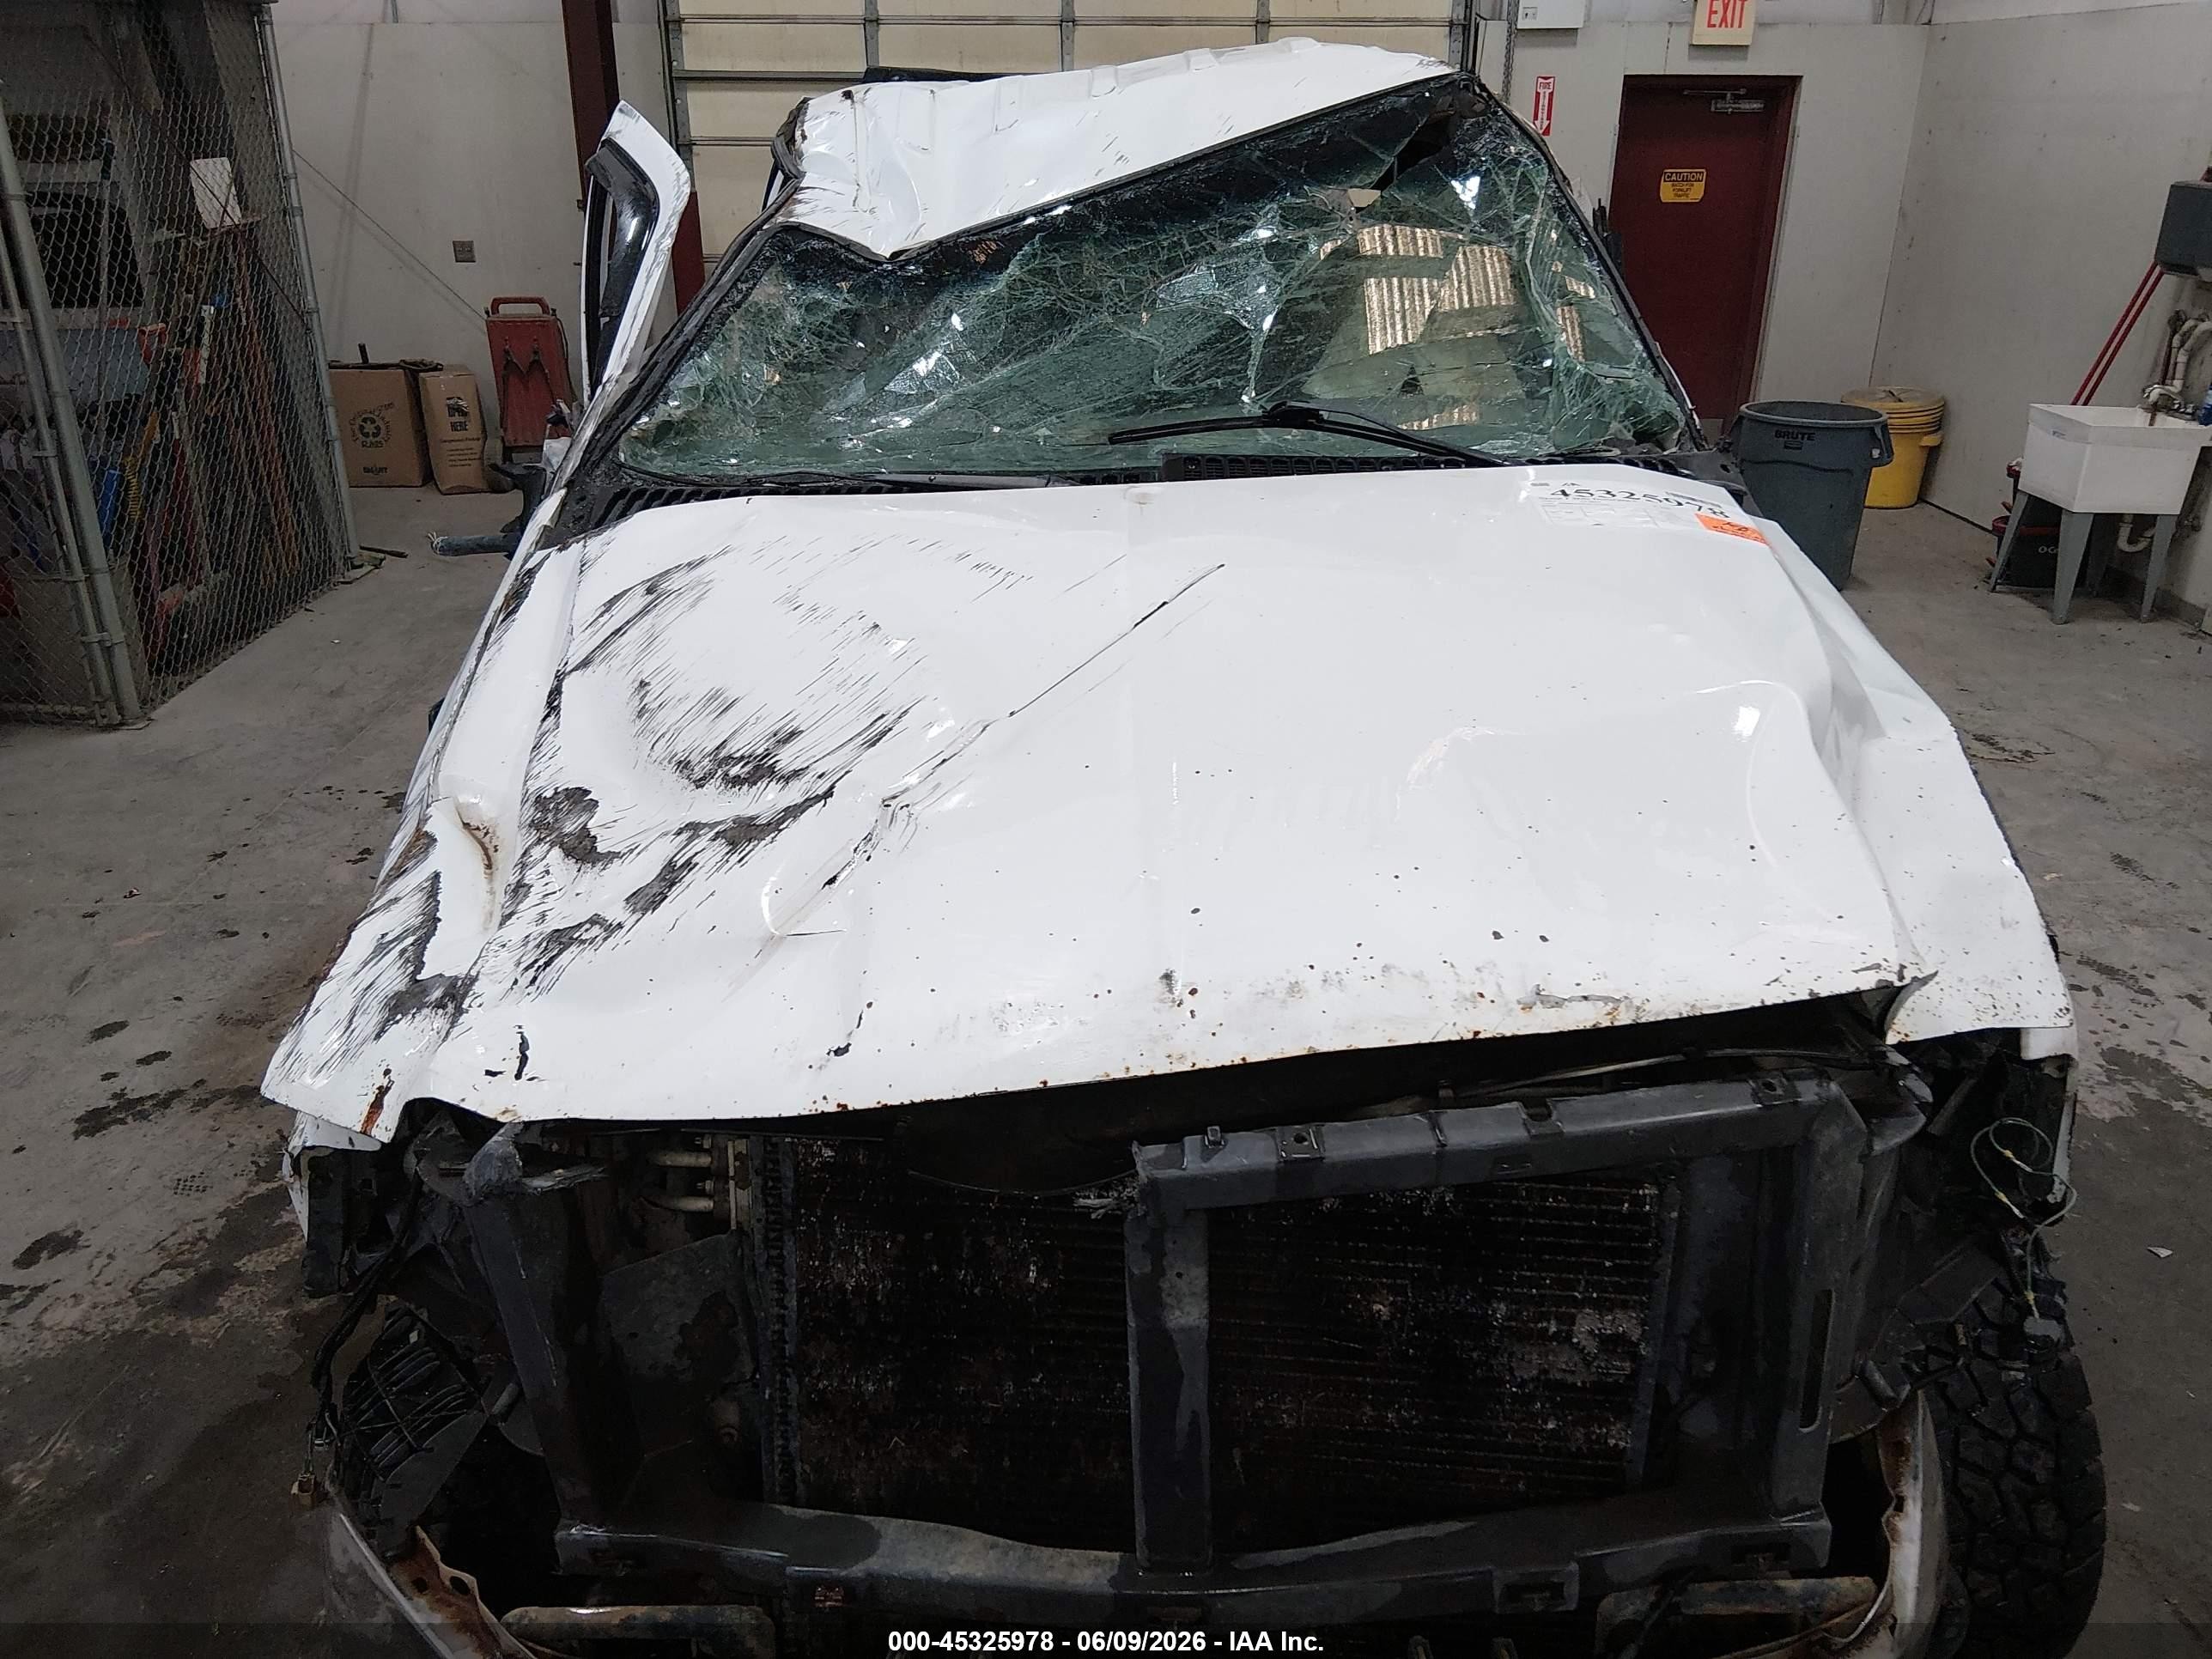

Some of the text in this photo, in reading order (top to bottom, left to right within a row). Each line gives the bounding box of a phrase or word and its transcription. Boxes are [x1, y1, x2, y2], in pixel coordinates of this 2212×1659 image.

[1707, 0, 1748, 28] EXIT
[1539, 82, 1553, 90] FIRE
[1664, 173, 1704, 181] CAUTION
[1774, 429, 1816, 441] BRUTE
[1550, 489, 1731, 519] 45325978
